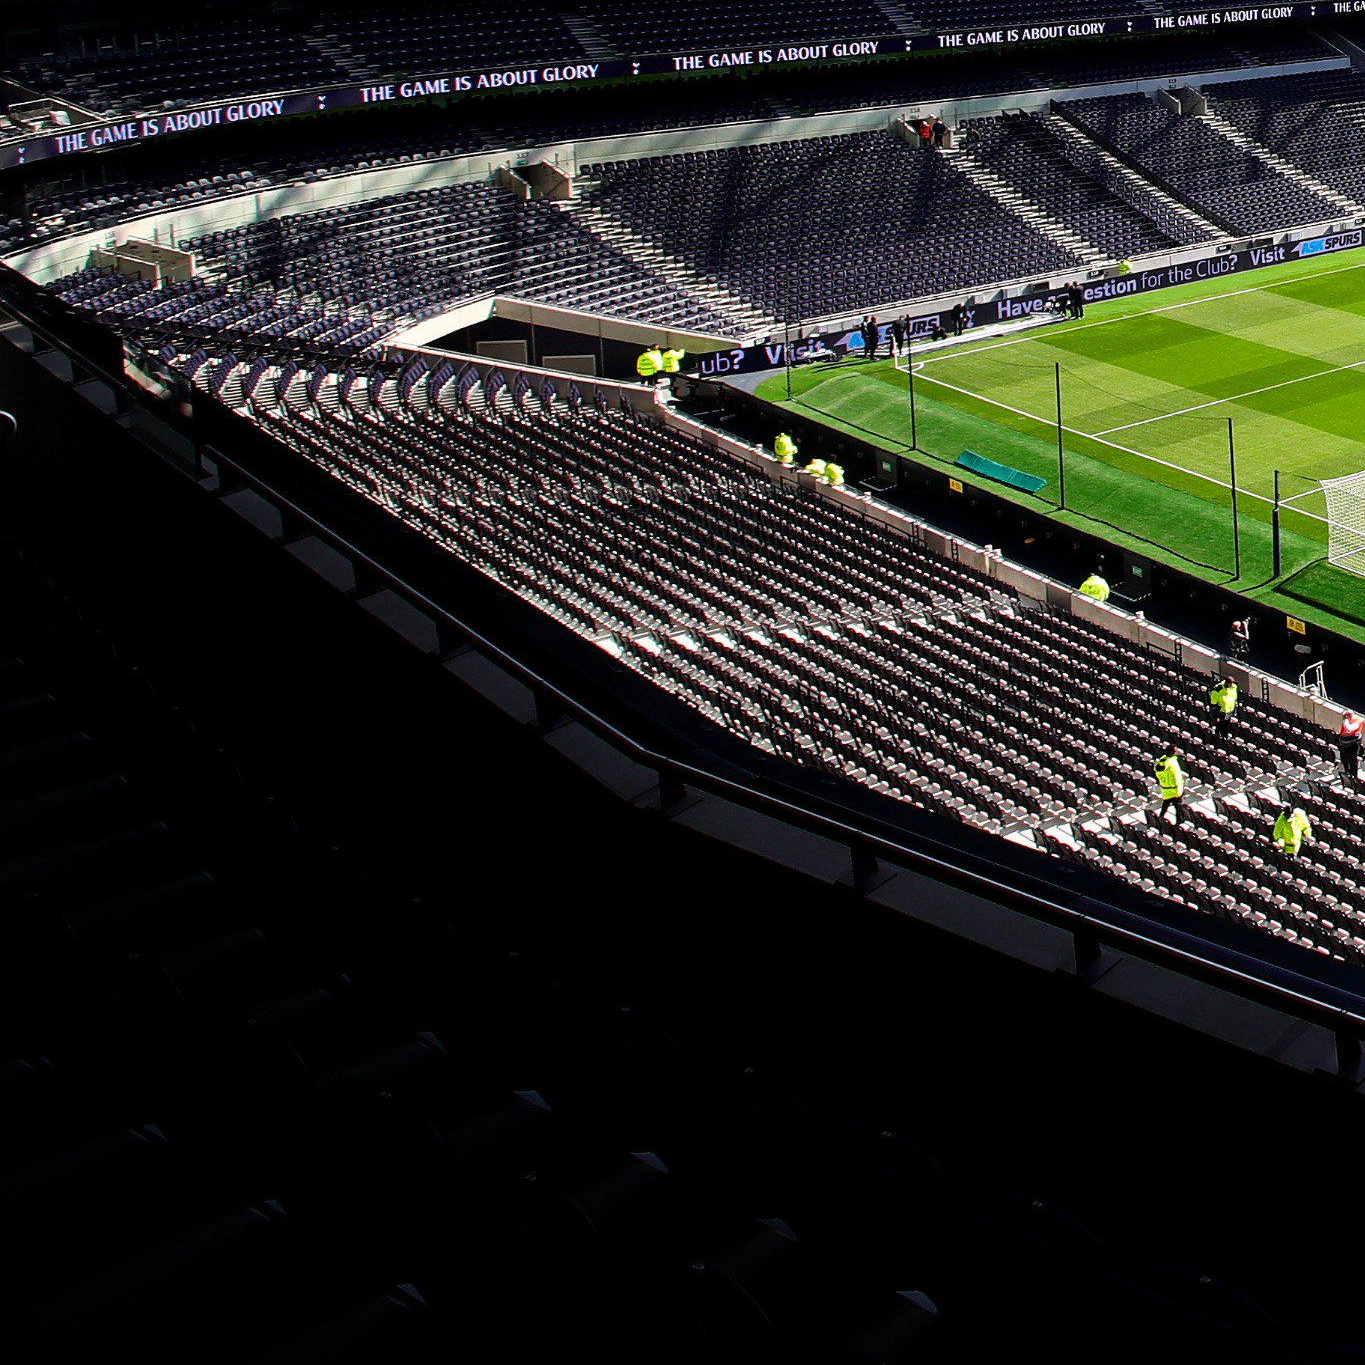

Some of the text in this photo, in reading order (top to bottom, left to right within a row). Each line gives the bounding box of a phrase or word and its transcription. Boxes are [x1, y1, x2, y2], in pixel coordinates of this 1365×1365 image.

[938, 23, 1105, 47] THE GAME IS ABOUT GLORY
[673, 42, 878, 70] THE GAME IS ABOUT GLORY
[360, 64, 598, 102] THE GAME IS ABOUT GLORY
[55, 99, 285, 152] THE GAME IS ABOUT GLORY
[997, 296, 1043, 318] Have
[1141, 273, 1164, 289] for
[1168, 267, 1192, 282] the
[1197, 255, 1238, 277] Club?
[1250, 244, 1285, 265] Visit
